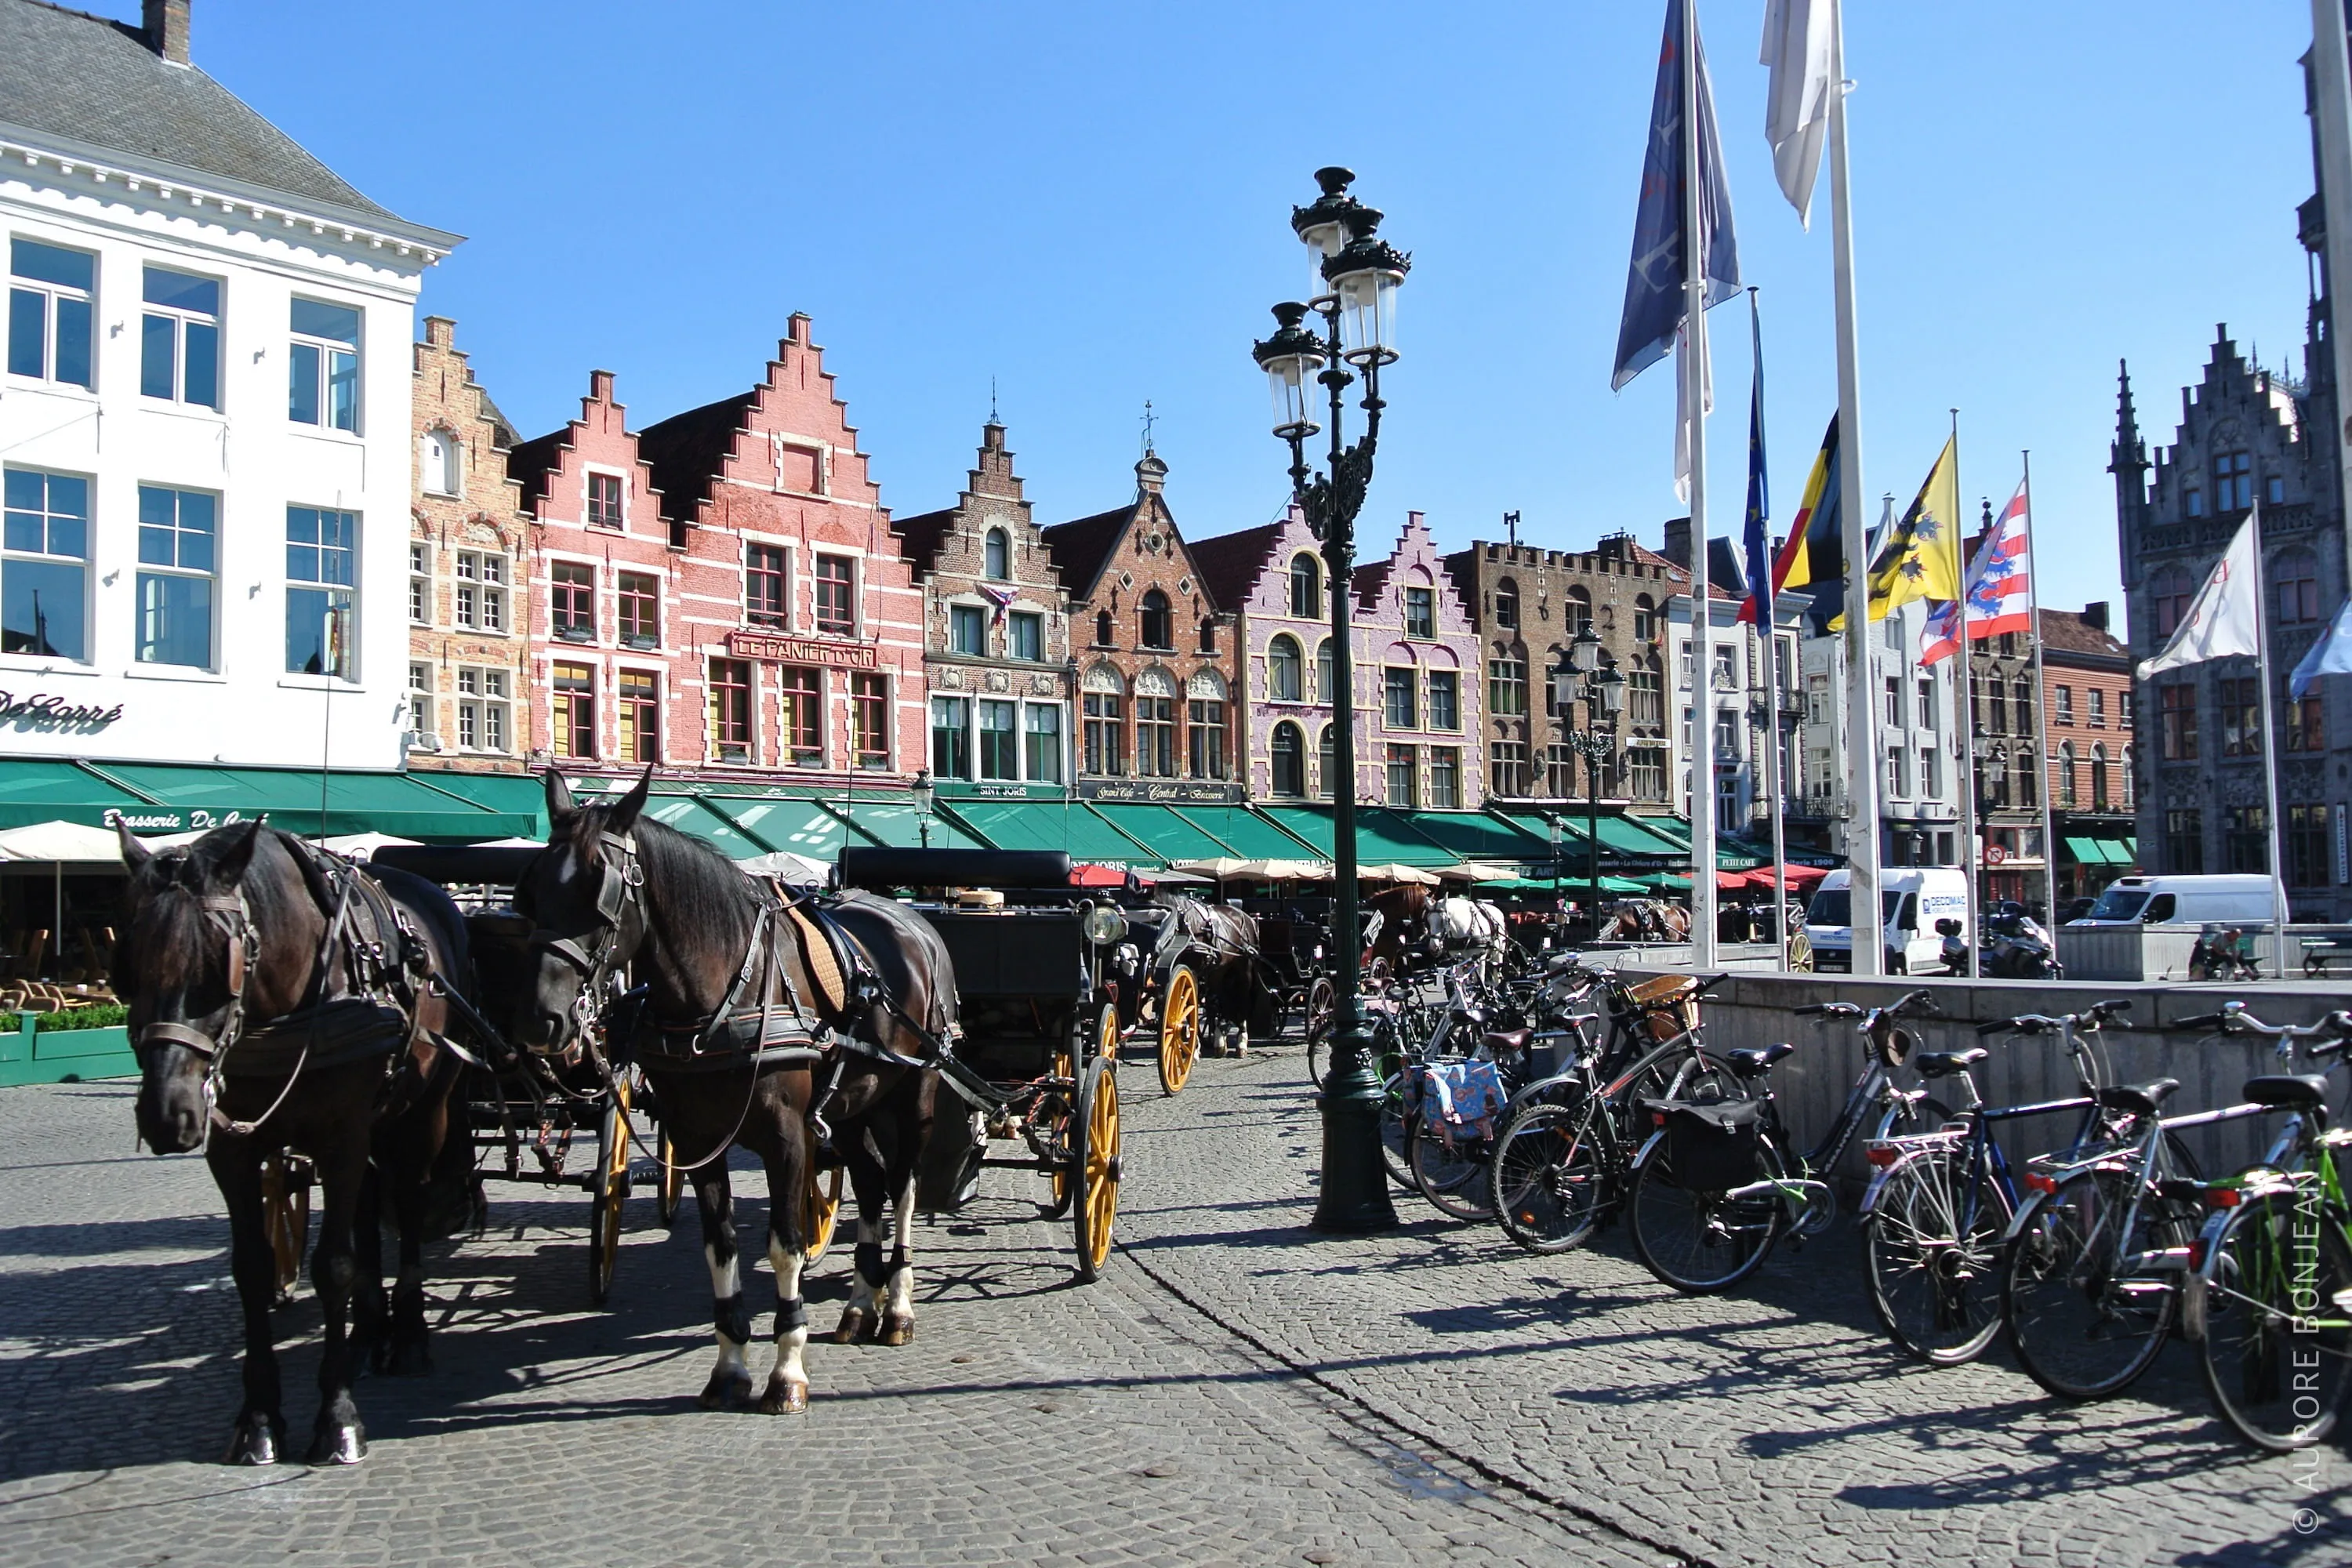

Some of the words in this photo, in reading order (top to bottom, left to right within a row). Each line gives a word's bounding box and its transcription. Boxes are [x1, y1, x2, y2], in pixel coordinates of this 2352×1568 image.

[738, 639, 762, 655] LE
[765, 639, 830, 661] PANIER
[834, 647, 873, 666] D'OR
[28, 694, 124, 723] Carré
[980, 786, 1000, 795] SINT
[1002, 786, 1026, 797] JORIS
[1098, 786, 1119, 799] Grand
[1148, 784, 1178, 800] Central
[1189, 789, 1225, 800] Brasserie
[188, 810, 217, 828] De
[1722, 858, 1740, 867] PETIT
